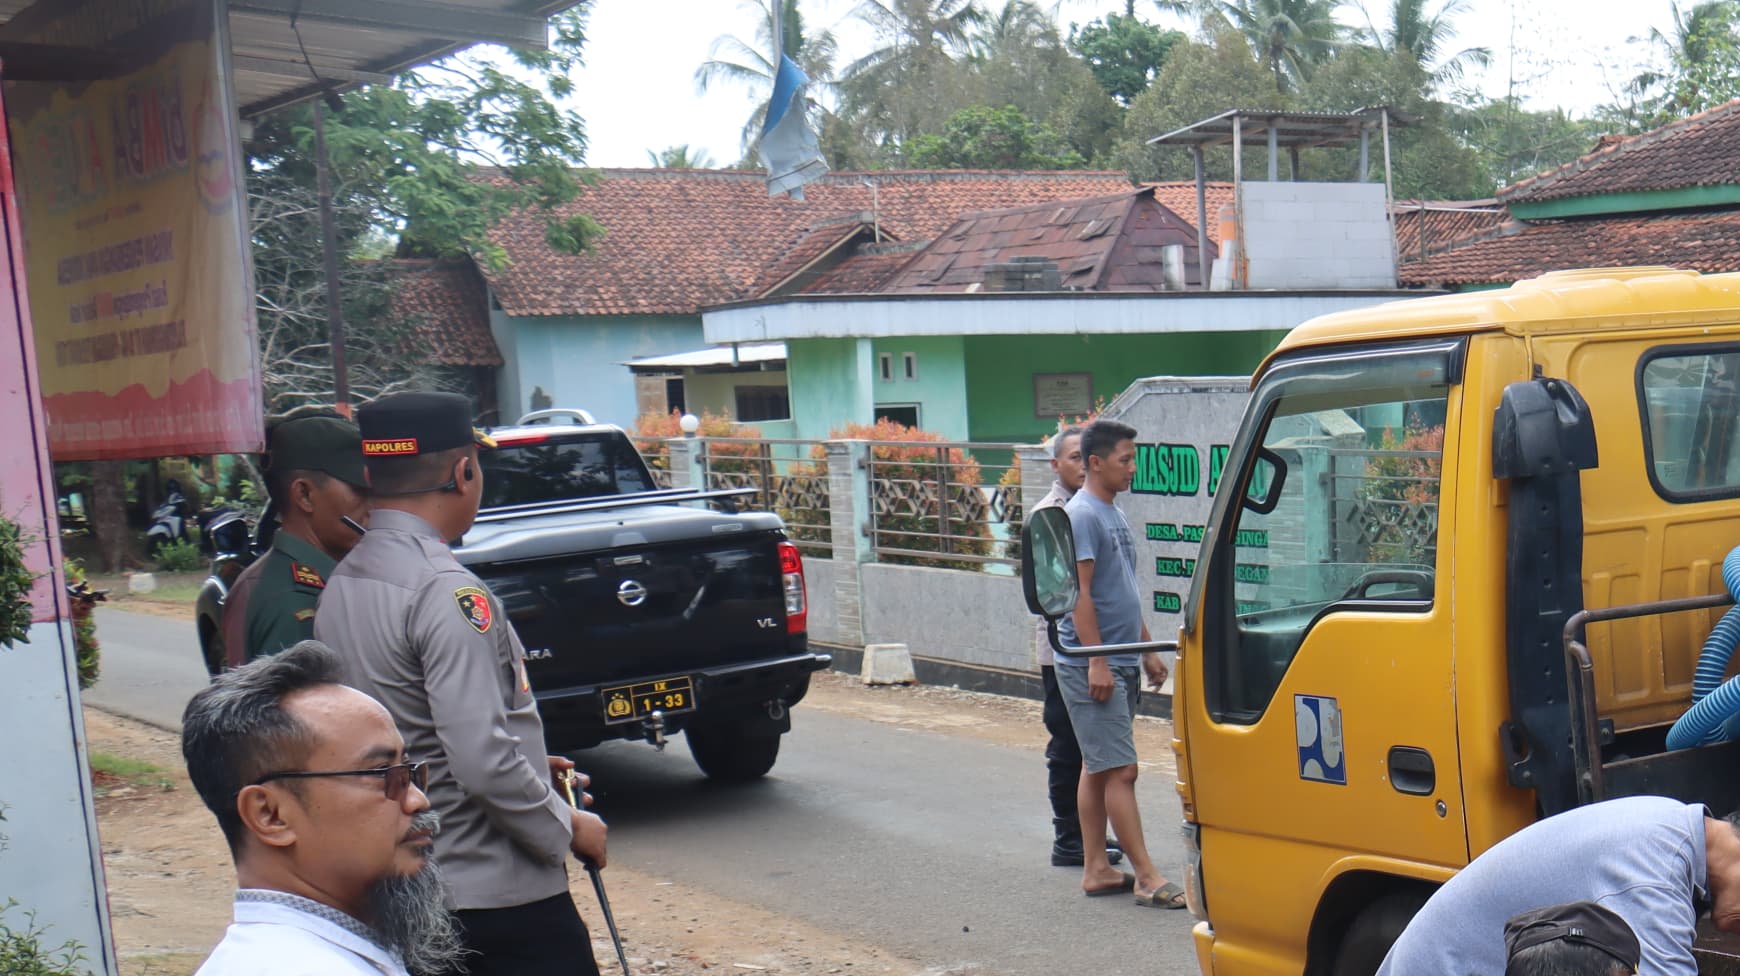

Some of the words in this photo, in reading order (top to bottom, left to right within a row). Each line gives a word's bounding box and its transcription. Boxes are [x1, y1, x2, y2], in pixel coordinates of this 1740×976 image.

[365, 441, 415, 453] KAPOLRES
[1131, 445, 1199, 494] MASJID
[757, 618, 777, 628] VL
[521, 649, 552, 660] ARA
[654, 682, 666, 691] IX
